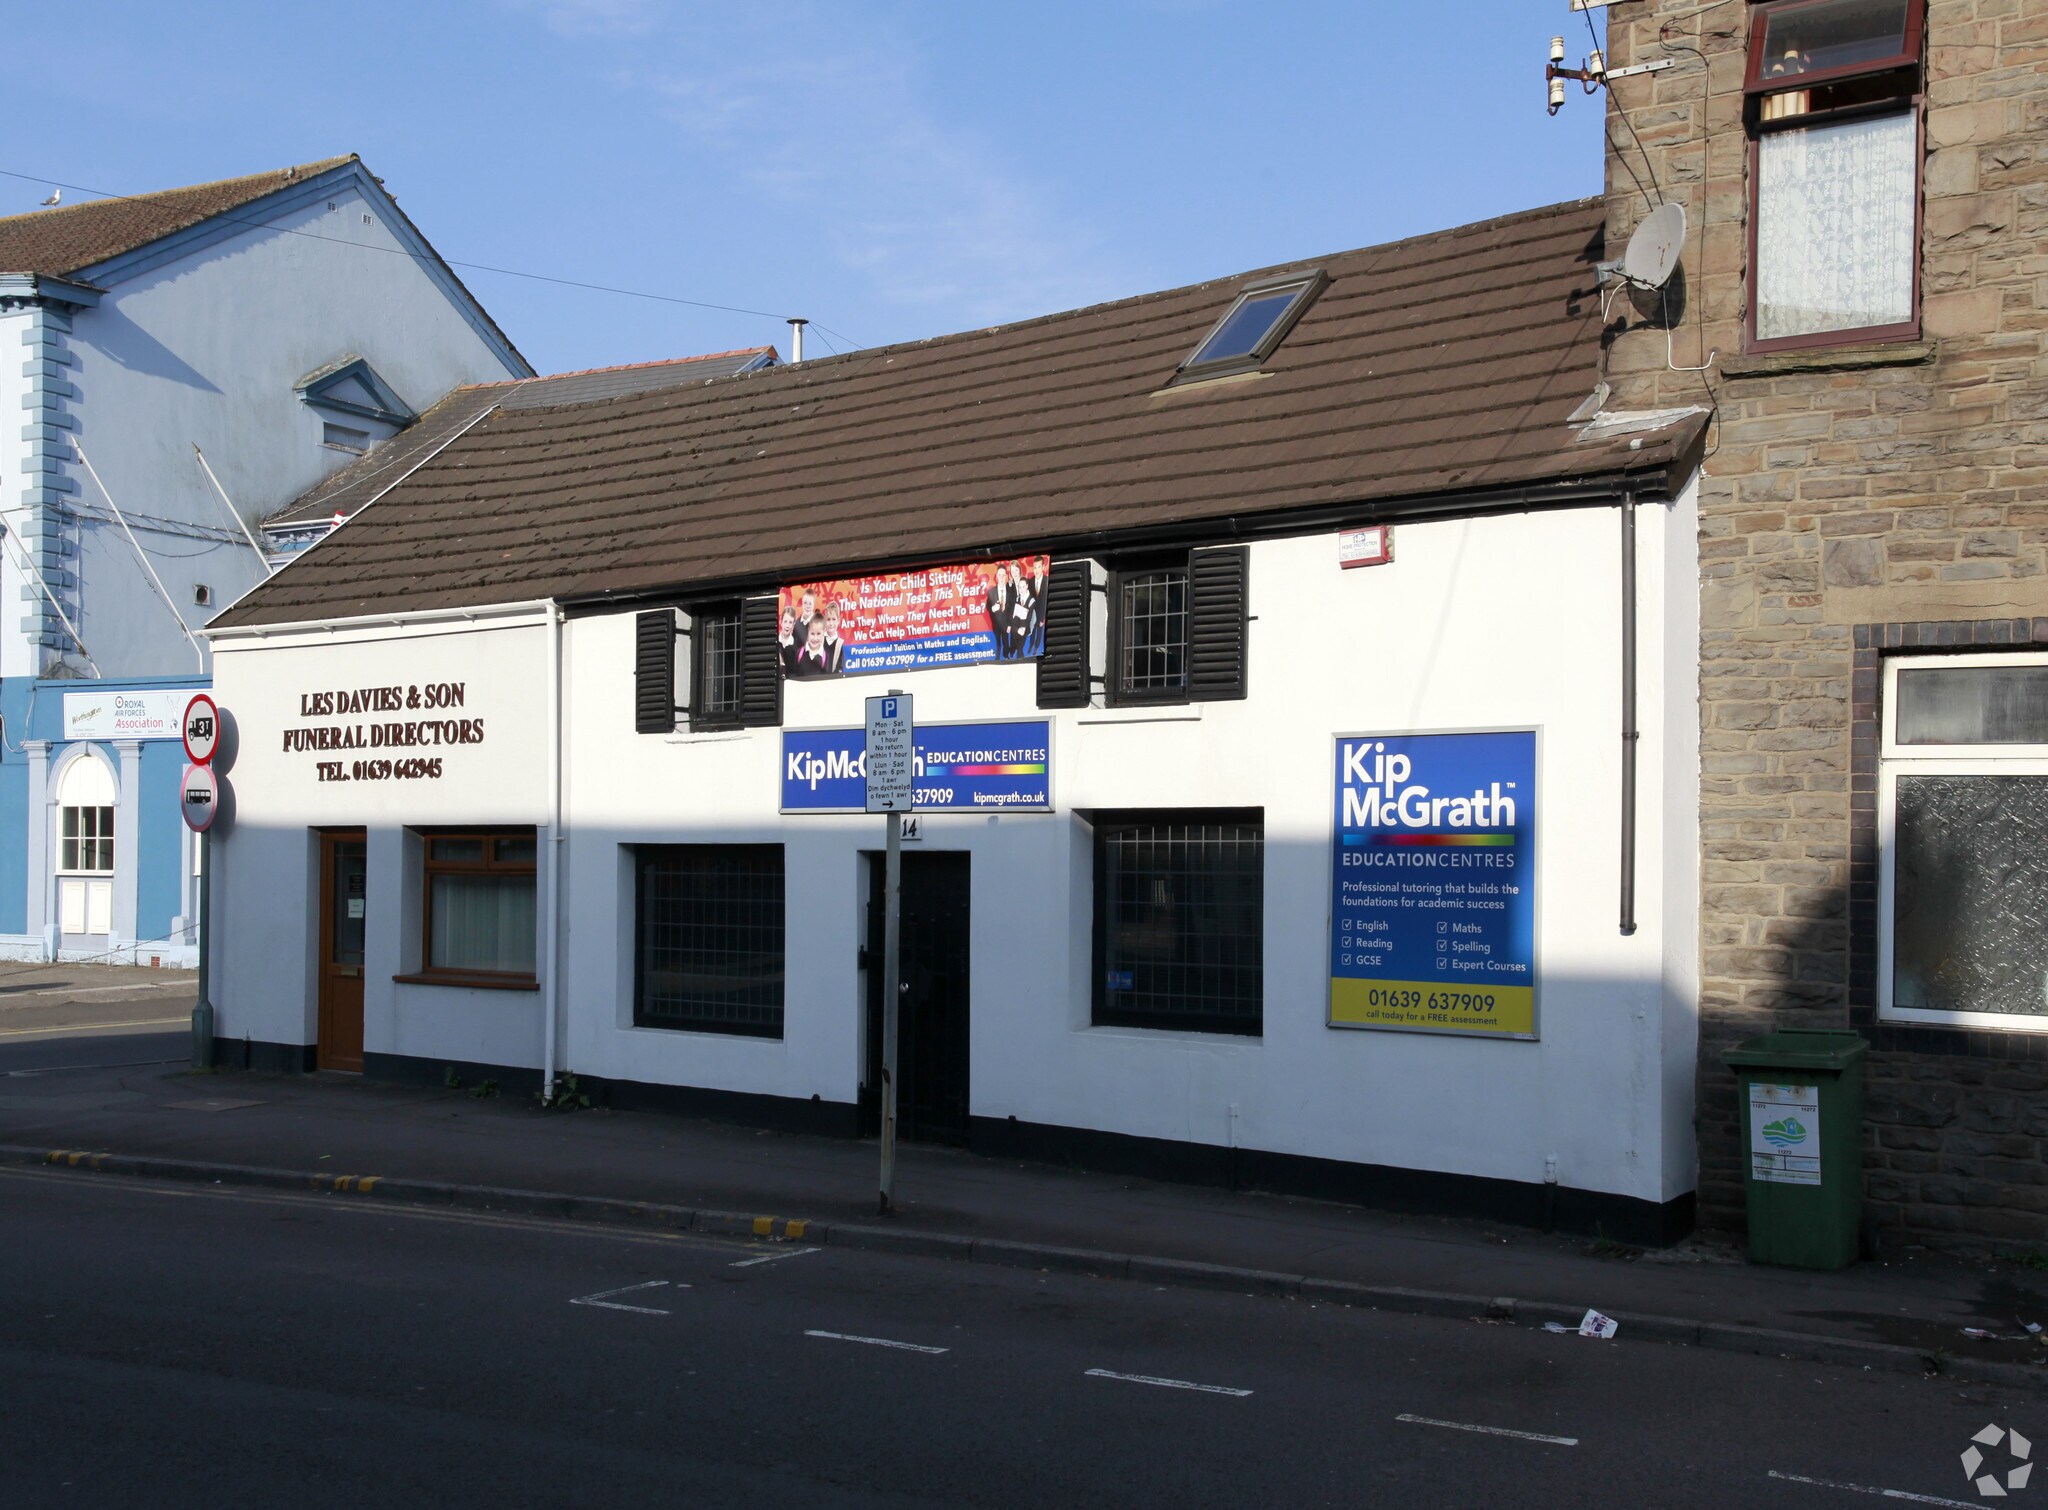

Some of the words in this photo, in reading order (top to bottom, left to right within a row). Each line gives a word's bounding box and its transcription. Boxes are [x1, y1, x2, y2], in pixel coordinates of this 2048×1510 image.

[861, 582, 869, 593] Is
[873, 580, 896, 592] Your
[900, 574, 926, 590] Child
[929, 572, 963, 586] Sitting
[839, 599, 857, 611] The
[860, 593, 903, 609] National
[907, 592, 930, 604] Tests
[935, 587, 953, 600] This
[957, 582, 987, 597] Year?
[841, 619, 855, 629] Are
[857, 616, 876, 628] They
[878, 612, 904, 625] Where
[907, 610, 926, 623] They
[929, 607, 953, 619] Need
[956, 605, 966, 616] To
[969, 603, 985, 614] Be?
[854, 630, 867, 641] We
[869, 629, 884, 640] Can
[886, 626, 904, 639] Help
[907, 624, 929, 636] Them
[932, 619, 970, 633] Achieve!
[851, 644, 892, 655] Professional
[894, 642, 915, 651] Tuition
[924, 638, 945, 649] Maths
[947, 637, 959, 646] and
[962, 634, 990, 646] English.
[846, 658, 860, 669] Call
[862, 657, 884, 667] 01639
[886, 654, 914, 666] 637909
[917, 654, 928, 664] for
[935, 652, 952, 662] FREE
[954, 649, 996, 660] assessment.
[124, 700, 145, 708] ROYAL
[300, 692, 333, 716] LES
[336, 686, 402, 714] DAVIES
[406, 685, 421, 709] &
[424, 682, 465, 709] SON
[886, 700, 895, 716] P
[115, 717, 163, 729] Association
[283, 725, 367, 752] FUNERAL
[370, 718, 484, 747] DIRECTORS
[317, 762, 350, 781] TEL.
[353, 759, 392, 781] 01639
[1344, 742, 1411, 798] Kip
[974, 791, 1045, 806] kipmcgrath.co.uk
[1343, 783, 1515, 827] McGrath
[902, 818, 917, 837] 14
[1343, 881, 1399, 892] Professional
[1402, 883, 1442, 895] tutoring
[1445, 883, 1465, 894] that
[1469, 883, 1498, 894] builds
[1502, 884, 1519, 894] the
[1343, 896, 1398, 907] foundations
[1401, 897, 1414, 908] for
[1418, 898, 1464, 909] academic
[1467, 900, 1505, 909] success
[1357, 920, 1388, 932] English
[1452, 923, 1482, 934] Maths
[1357, 938, 1392, 950] Reading
[1452, 941, 1491, 954] Spelling
[1356, 956, 1381, 965] GCSE
[1452, 959, 1484, 972] Expert
[1487, 961, 1526, 971] Courses
[1369, 989, 1421, 1008] 01639
[1428, 992, 1495, 1012] 637909
[1382, 1011, 1404, 1021] today
[1406, 1011, 1418, 1020] for
[1428, 1013, 1448, 1022] FREE
[1451, 1016, 1497, 1025] assessment
